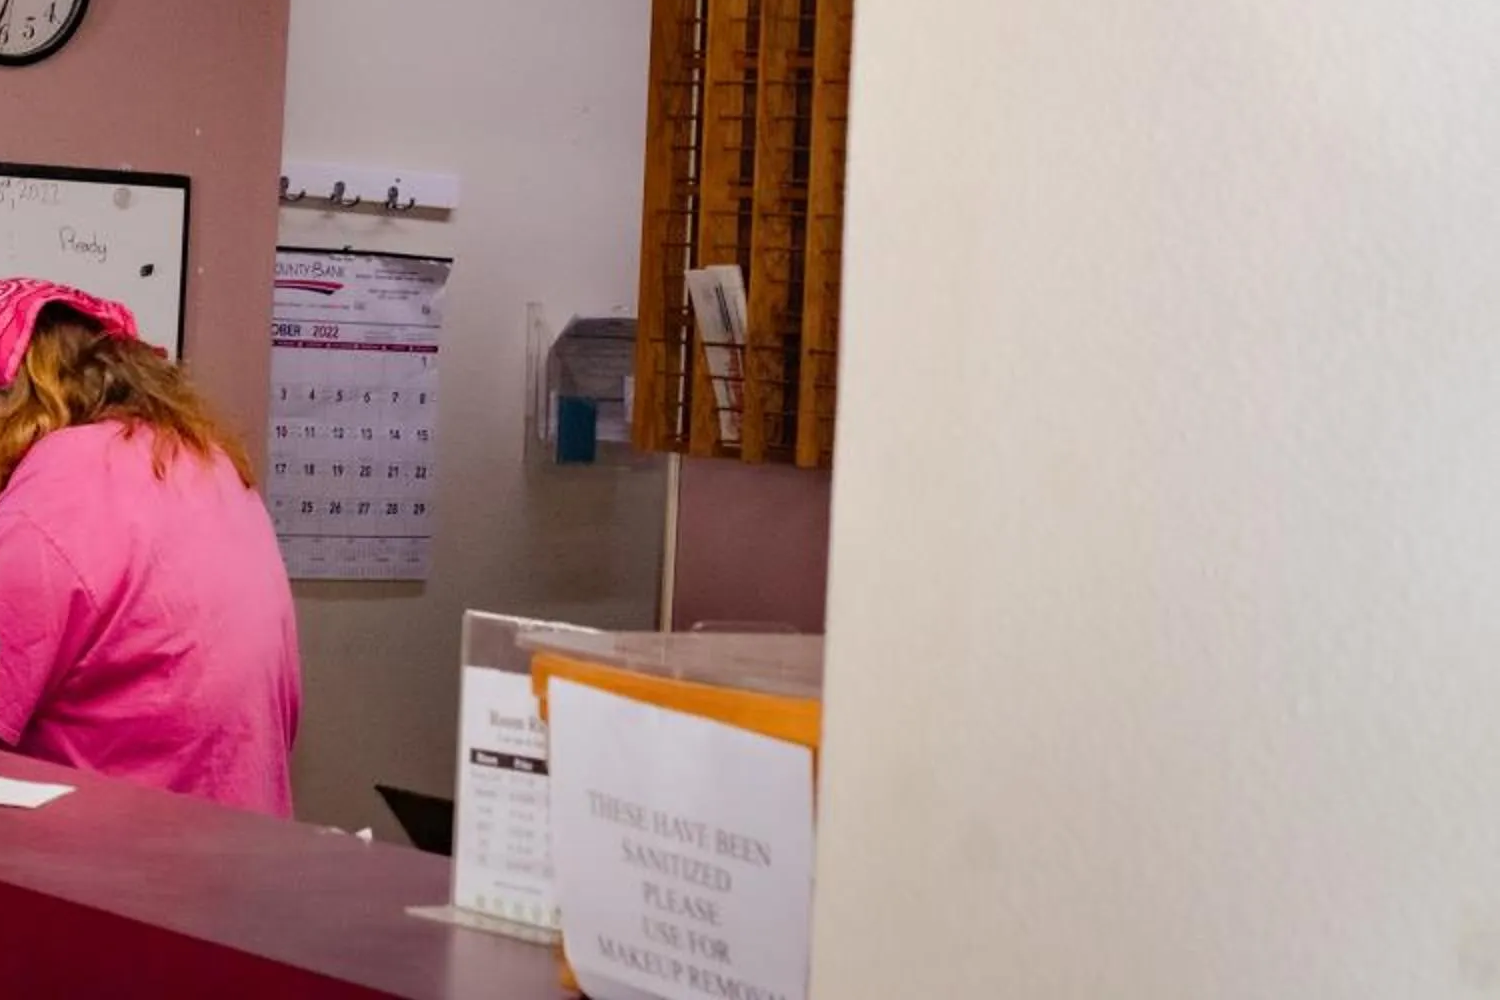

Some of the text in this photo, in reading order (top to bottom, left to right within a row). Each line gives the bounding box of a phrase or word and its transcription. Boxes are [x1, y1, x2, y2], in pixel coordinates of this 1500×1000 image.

[22, 16, 36, 39] 5
[312, 325, 340, 341] 2022
[586, 788, 772, 867] THESE HAVE BEEN
[621, 836, 732, 893] SANITIZED
[642, 880, 724, 926] PLEASE
[597, 932, 683, 984] MAKEUP
[641, 916, 732, 966] USE FOR
